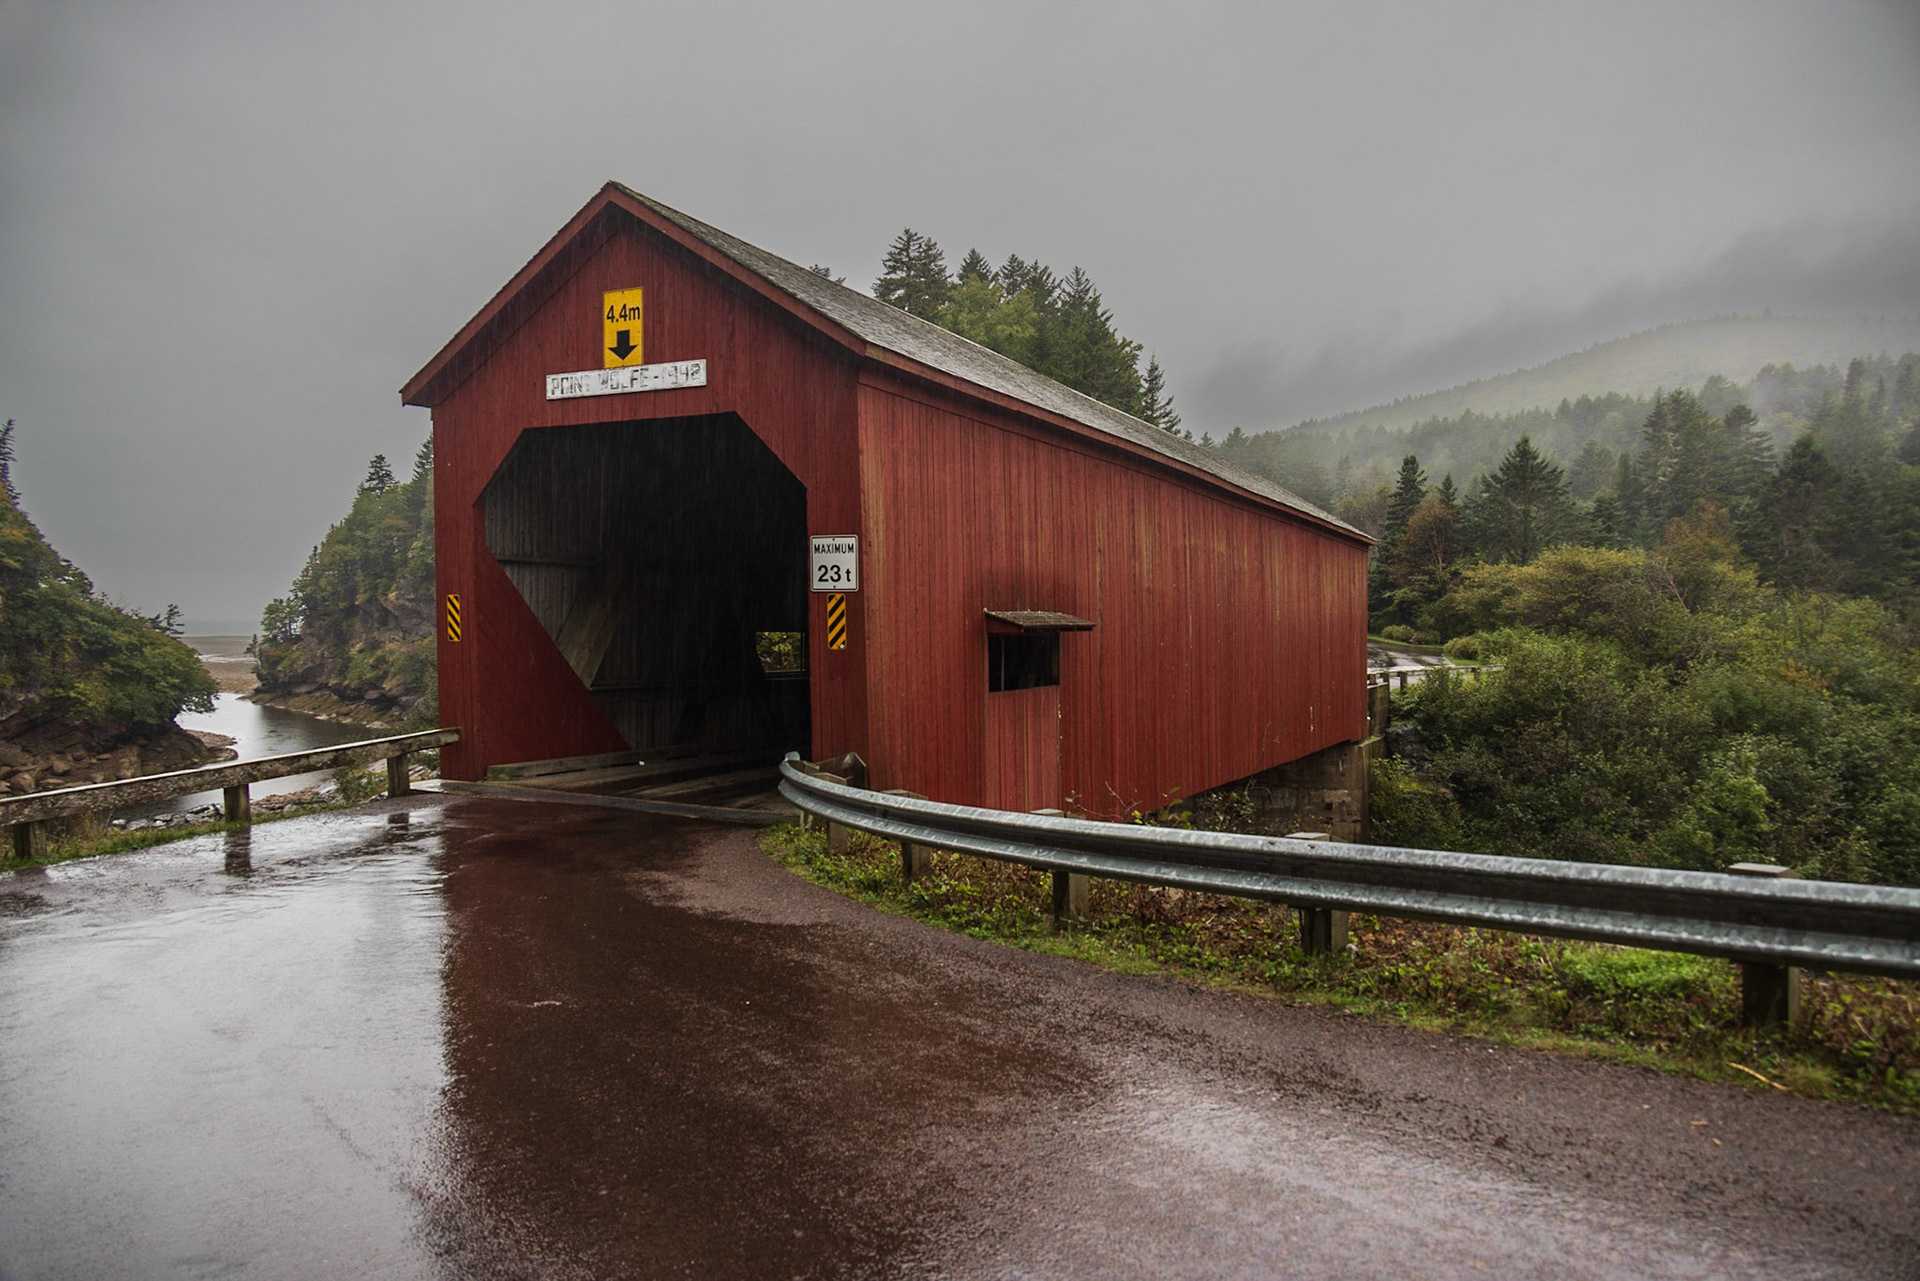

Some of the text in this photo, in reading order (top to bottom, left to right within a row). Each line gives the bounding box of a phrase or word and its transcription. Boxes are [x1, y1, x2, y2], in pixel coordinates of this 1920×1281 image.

[606, 303, 640, 323] 4.4m
[814, 543, 854, 554] MAXIMUM
[818, 565, 851, 582] 23 t
